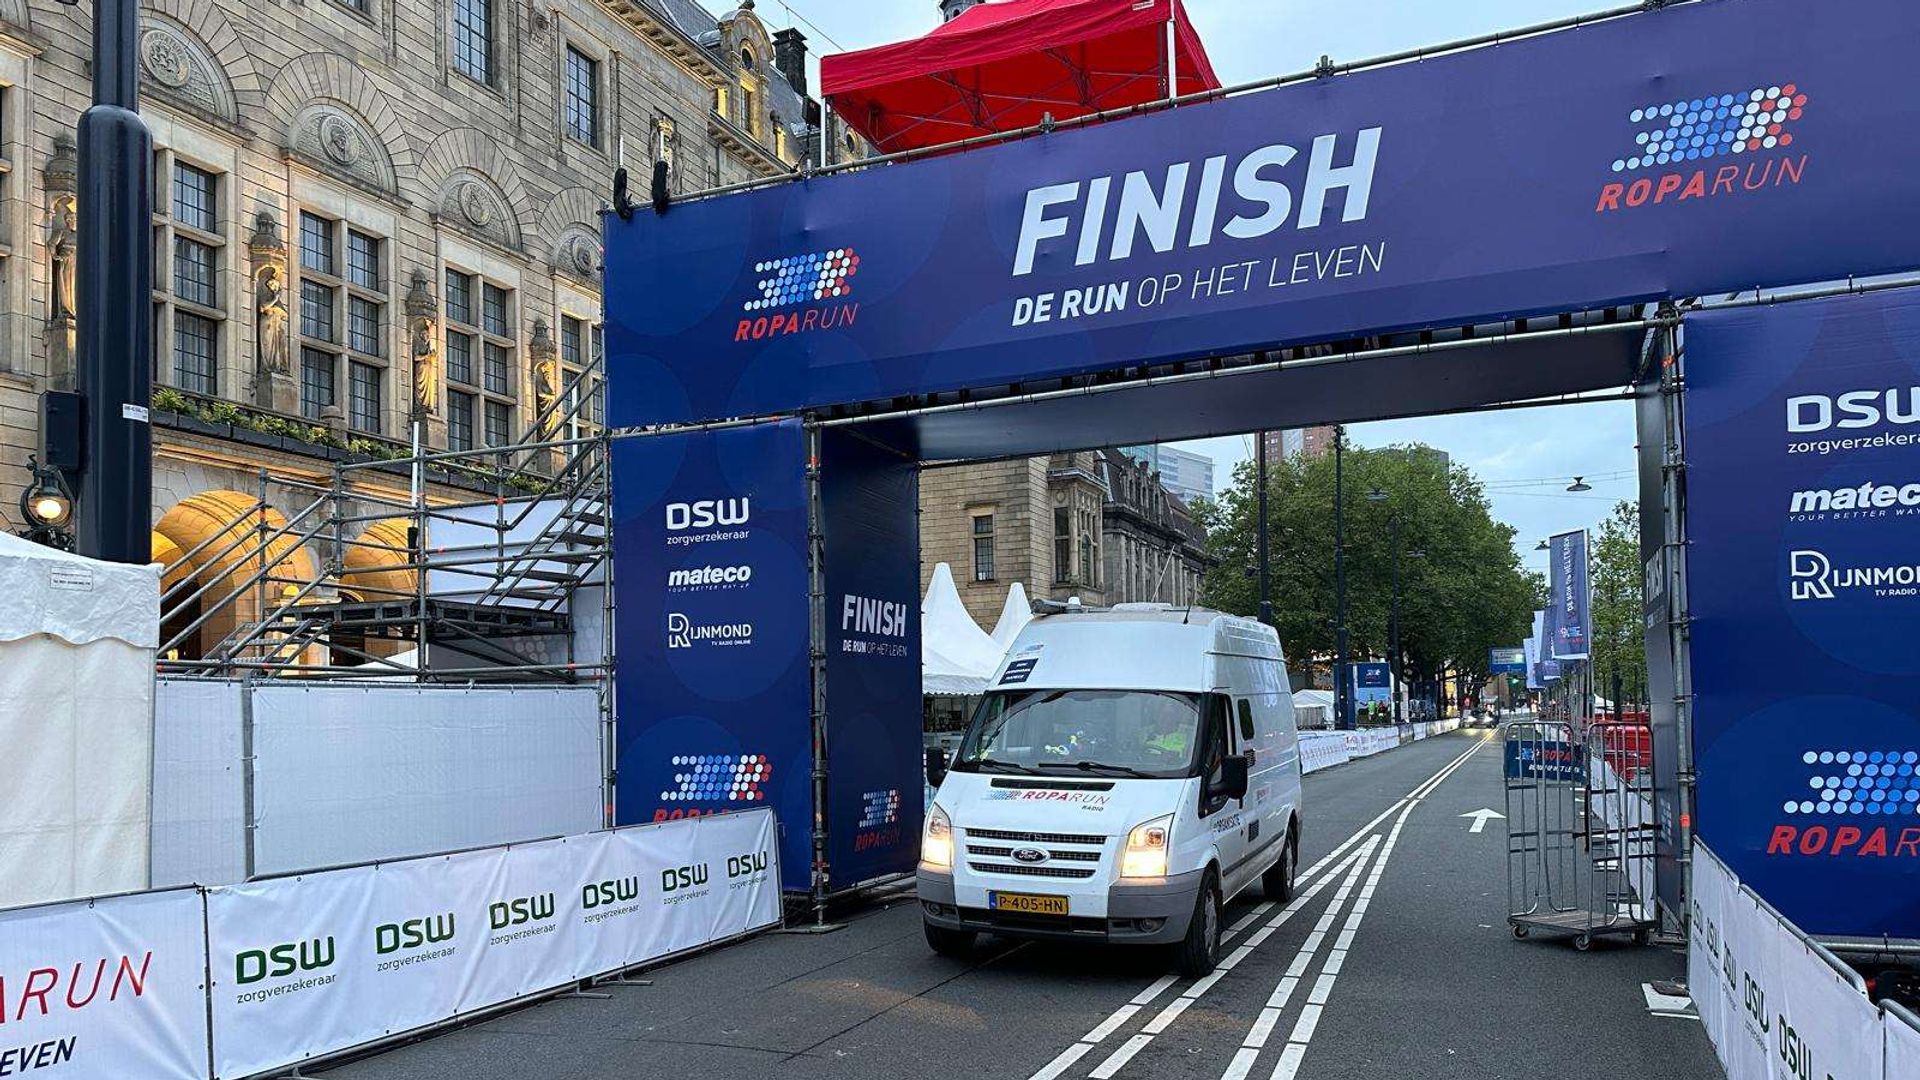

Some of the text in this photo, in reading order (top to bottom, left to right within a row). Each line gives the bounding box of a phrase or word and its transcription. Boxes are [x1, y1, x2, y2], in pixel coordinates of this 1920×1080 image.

[1596, 155, 1808, 212] ROPARUN
[1012, 126, 1383, 276] FINISH
[1012, 241, 1385, 327] DE RUN OP HET LEVEN
[735, 303, 859, 342] ROPARUN
[666, 497, 750, 530] DSW
[1789, 514, 1825, 522] YOUR
[1833, 510, 1886, 520] BETTER
[666, 530, 750, 546] zorgverzekeraar
[668, 565, 752, 586] mateco
[1888, 588, 1917, 596] RADIO
[668, 613, 752, 648] RIJNMOND
[843, 594, 907, 637] FINISH
[1022, 791, 1111, 805] ROPARUN
[662, 863, 708, 892] DSW
[727, 850, 767, 878] DSW
[582, 876, 639, 909] DSW
[1000, 895, 1063, 912] P-405-HN
[489, 892, 555, 930] DSW
[583, 904, 640, 923] zorgverzekeraar
[375, 911, 456, 955] DSW
[490, 923, 557, 946] zorgverzekeraar
[236, 936, 336, 984] DSW
[376, 947, 456, 972] zorgverzekeraar
[0, 951, 153, 1025] RUN
[237, 974, 337, 1004] zorgverzekeraar
